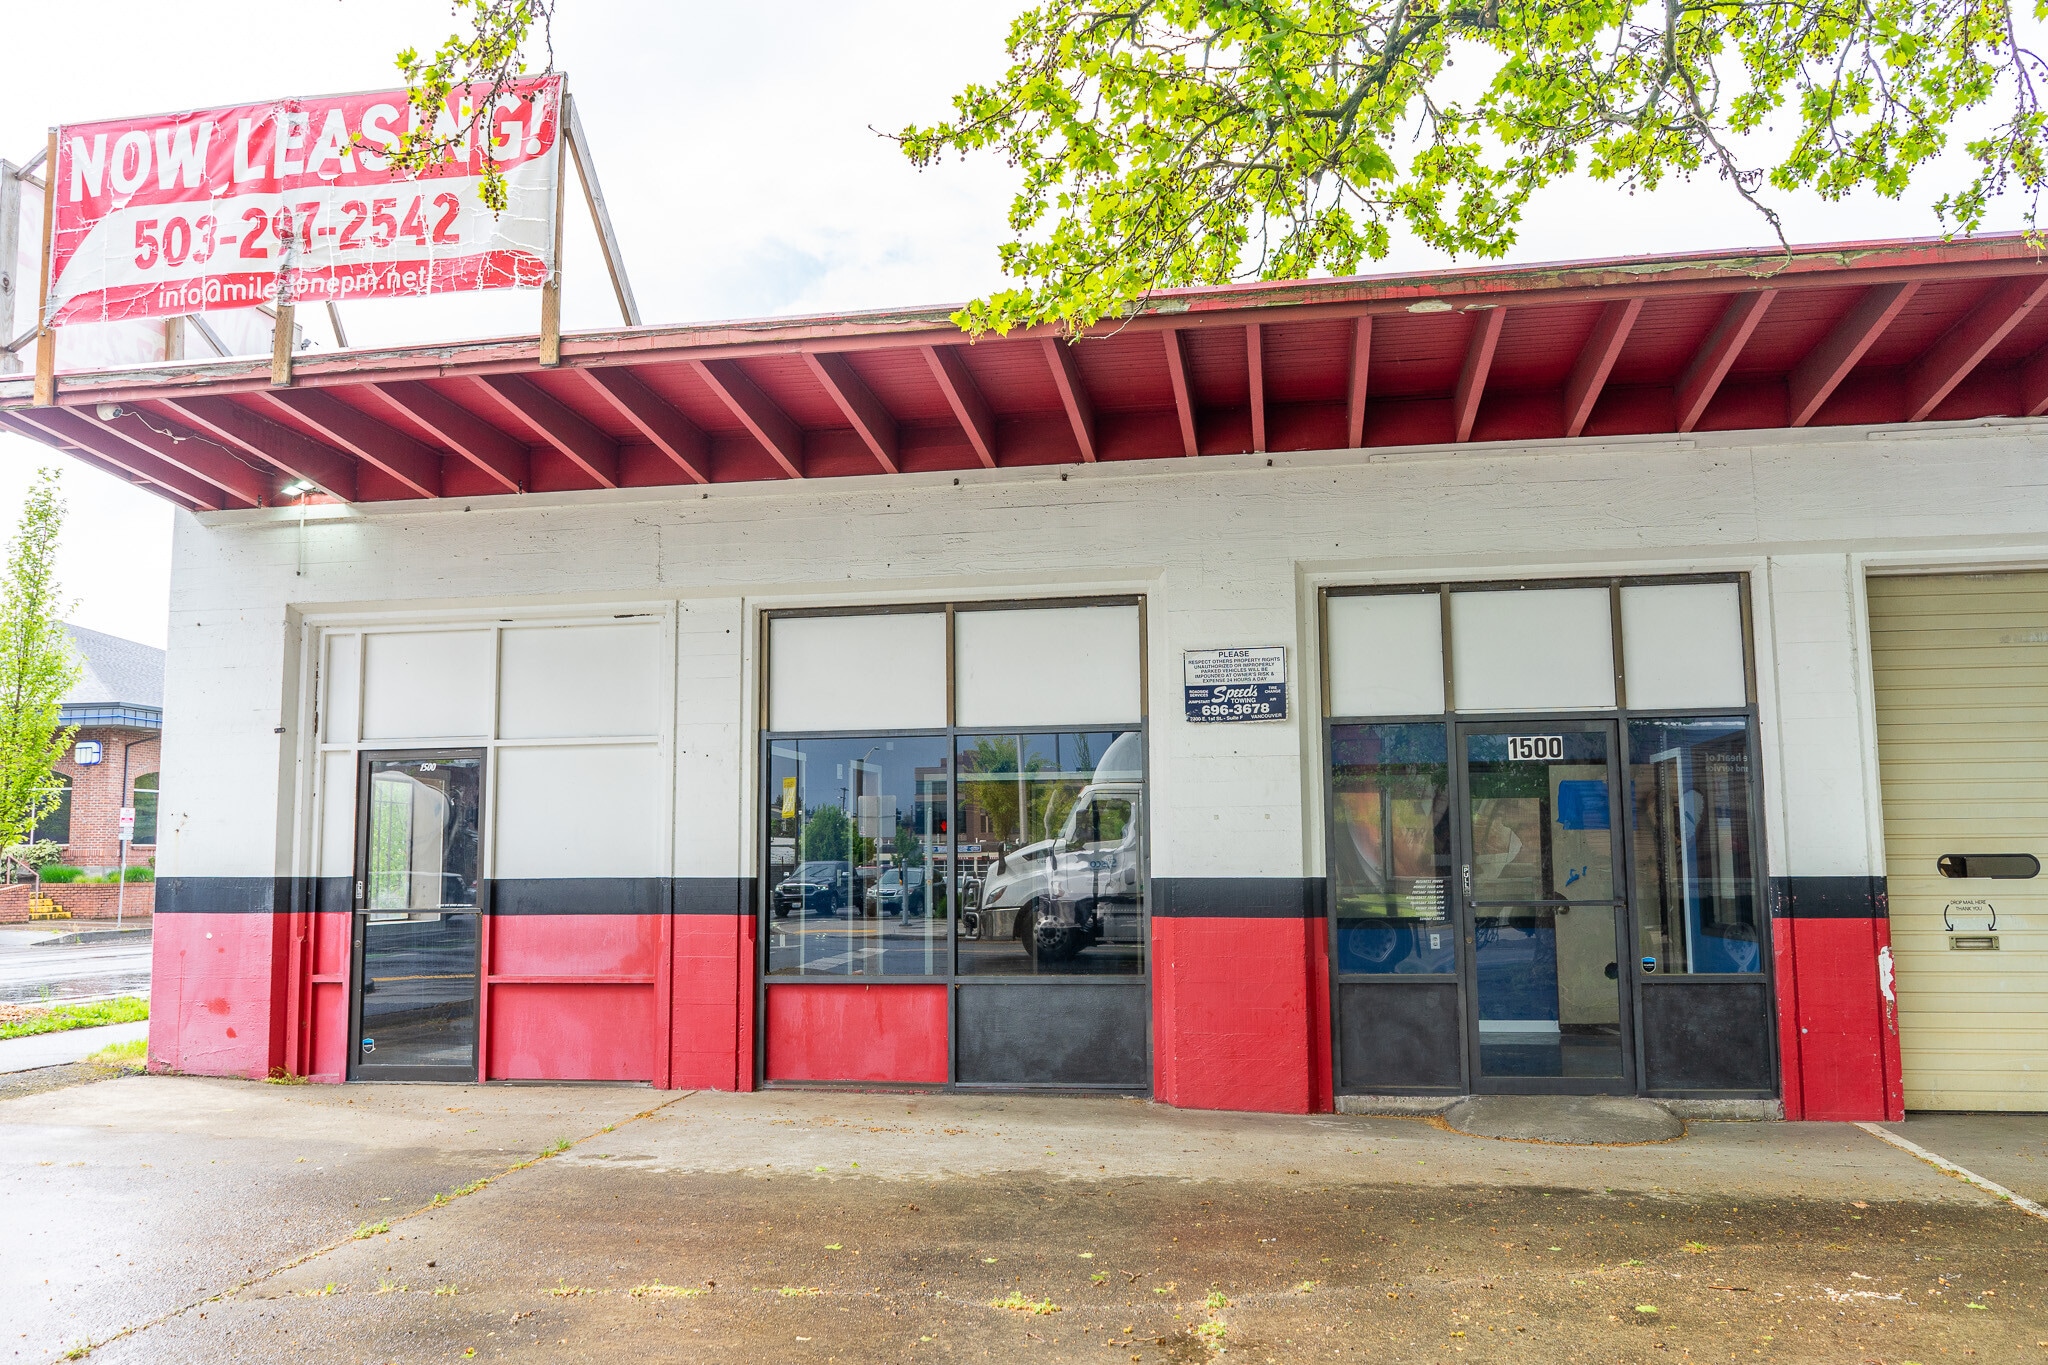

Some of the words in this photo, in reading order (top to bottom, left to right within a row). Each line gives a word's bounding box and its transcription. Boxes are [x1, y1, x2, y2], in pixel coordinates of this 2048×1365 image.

[70, 121, 214, 202] NOW
[134, 192, 460, 270] 503-297-2542
[158, 265, 427, 309] info@miletonepm.net
[1218, 650, 1250, 658] PLEASE
[1211, 685, 1258, 704] Speed's
[1201, 703, 1270, 716] 696-3678
[1509, 737, 1562, 759] 1500
[420, 762, 437, 771] 1500
